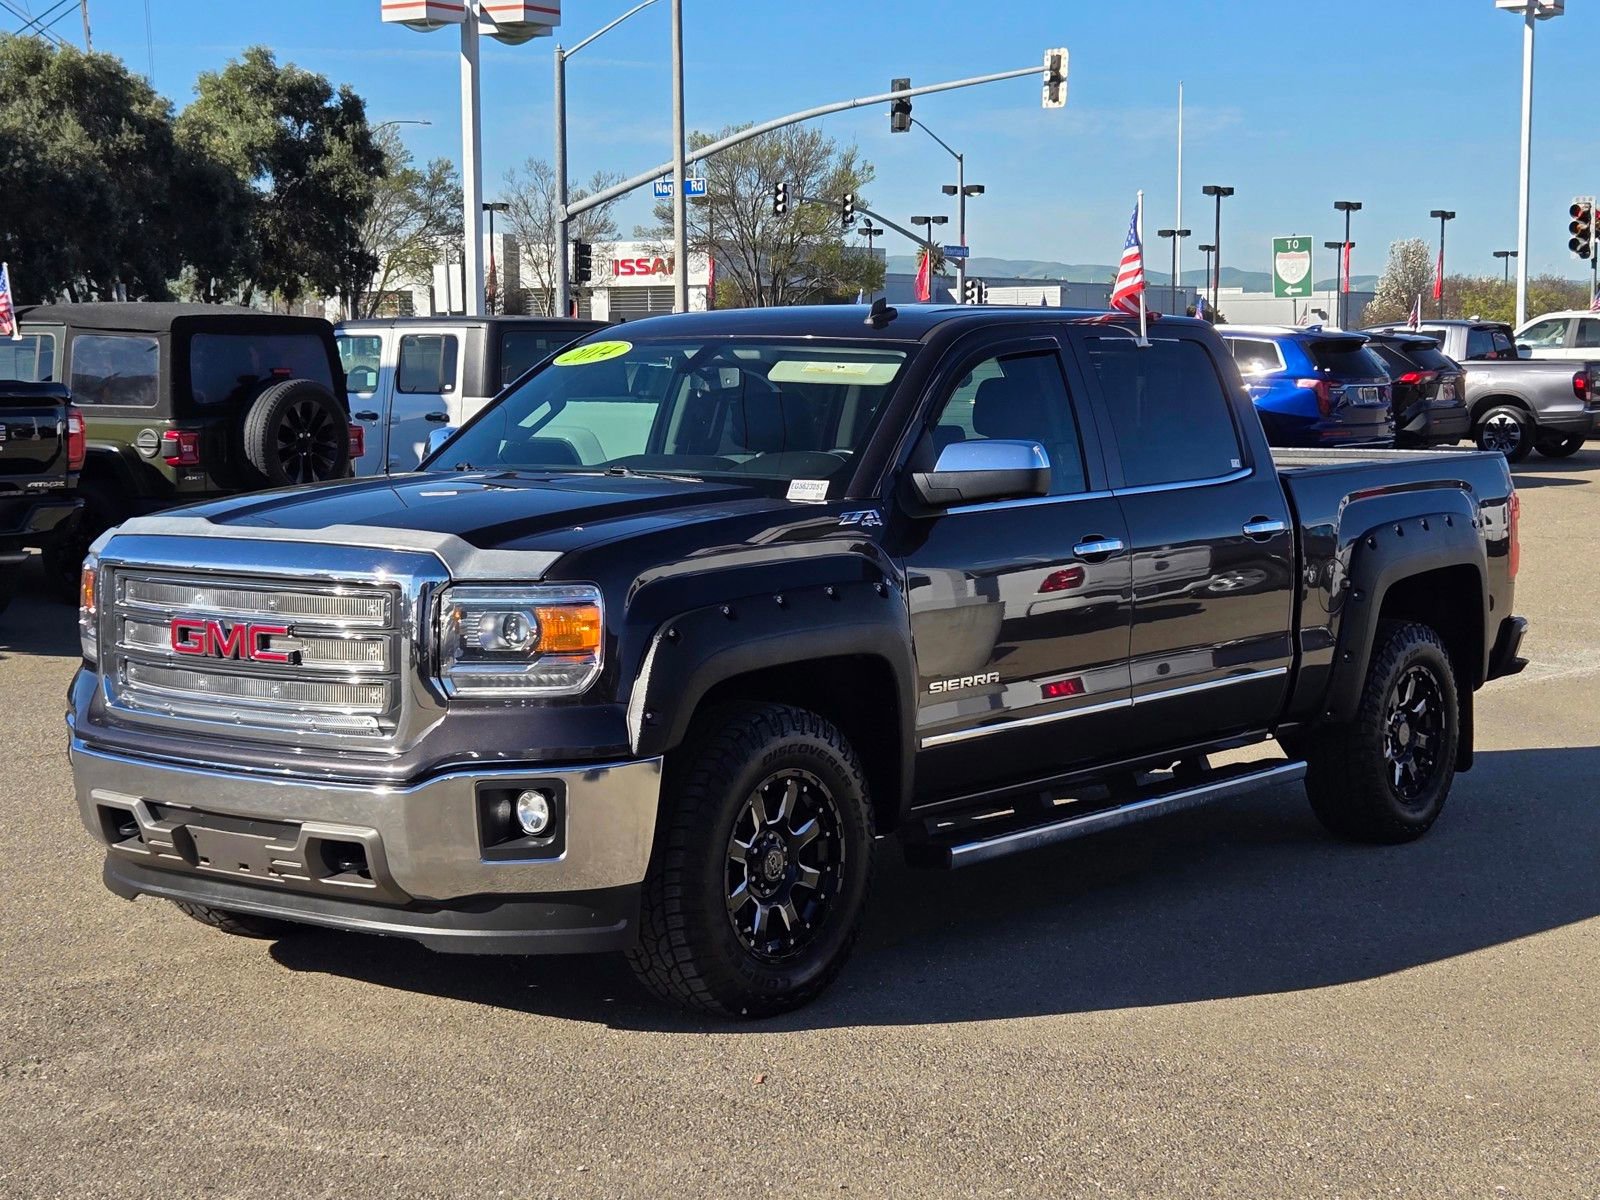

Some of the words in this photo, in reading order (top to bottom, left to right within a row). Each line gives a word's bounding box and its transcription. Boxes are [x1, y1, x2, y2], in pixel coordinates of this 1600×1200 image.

[690, 180, 704, 192] Rd
[1286, 239, 1299, 250] TO
[170, 617, 290, 664] GMC
[928, 671, 1000, 695] SIERRA
[762, 743, 852, 786] DISCOVERER
